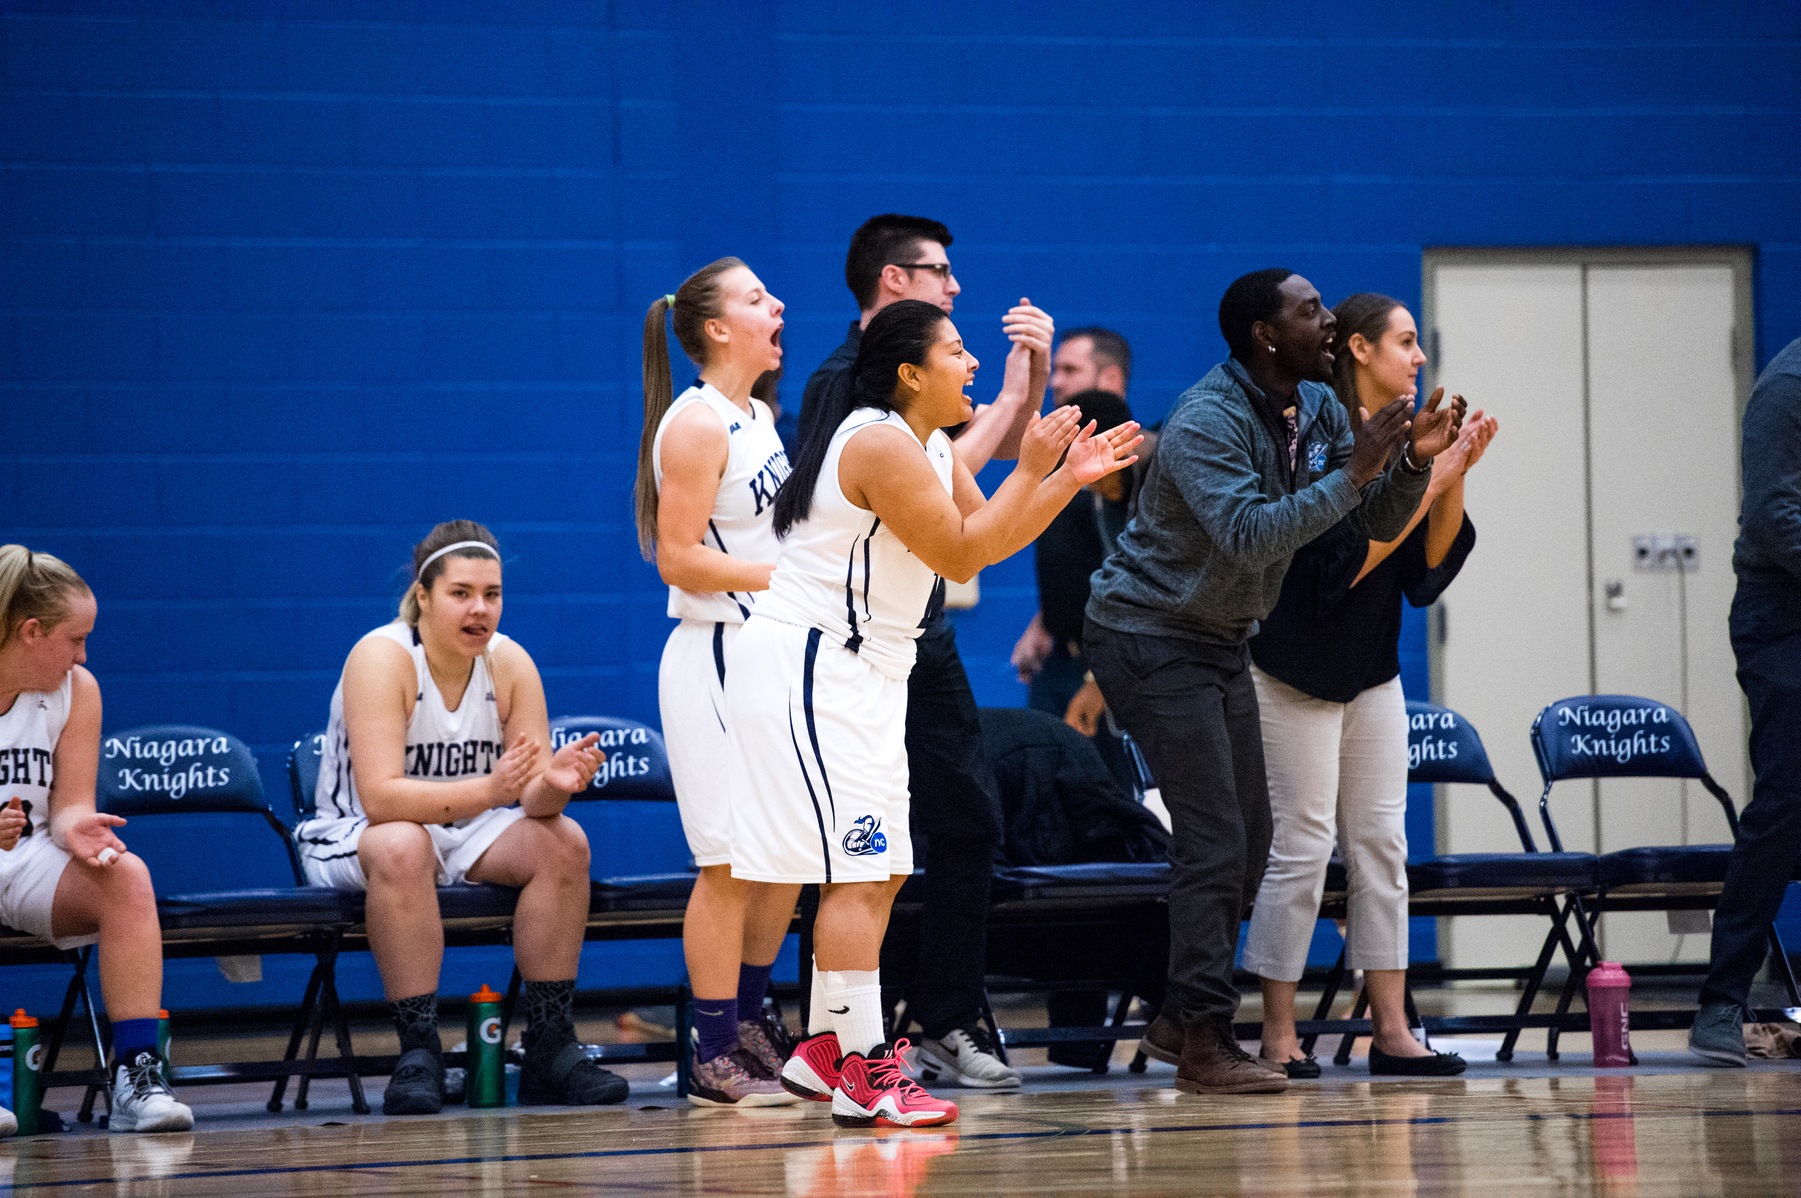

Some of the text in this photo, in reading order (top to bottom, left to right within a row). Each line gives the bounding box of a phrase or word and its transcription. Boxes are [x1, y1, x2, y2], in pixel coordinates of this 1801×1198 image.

[1557, 704, 1671, 734] Niagara
[105, 735, 232, 767] Niagara
[1408, 734, 1458, 770] ghts
[1571, 730, 1671, 764] Knights
[118, 762, 230, 800] Knights
[592, 751, 650, 788] ghts
[479, 1017, 502, 1044] G
[1620, 1001, 1629, 1050] GNC
